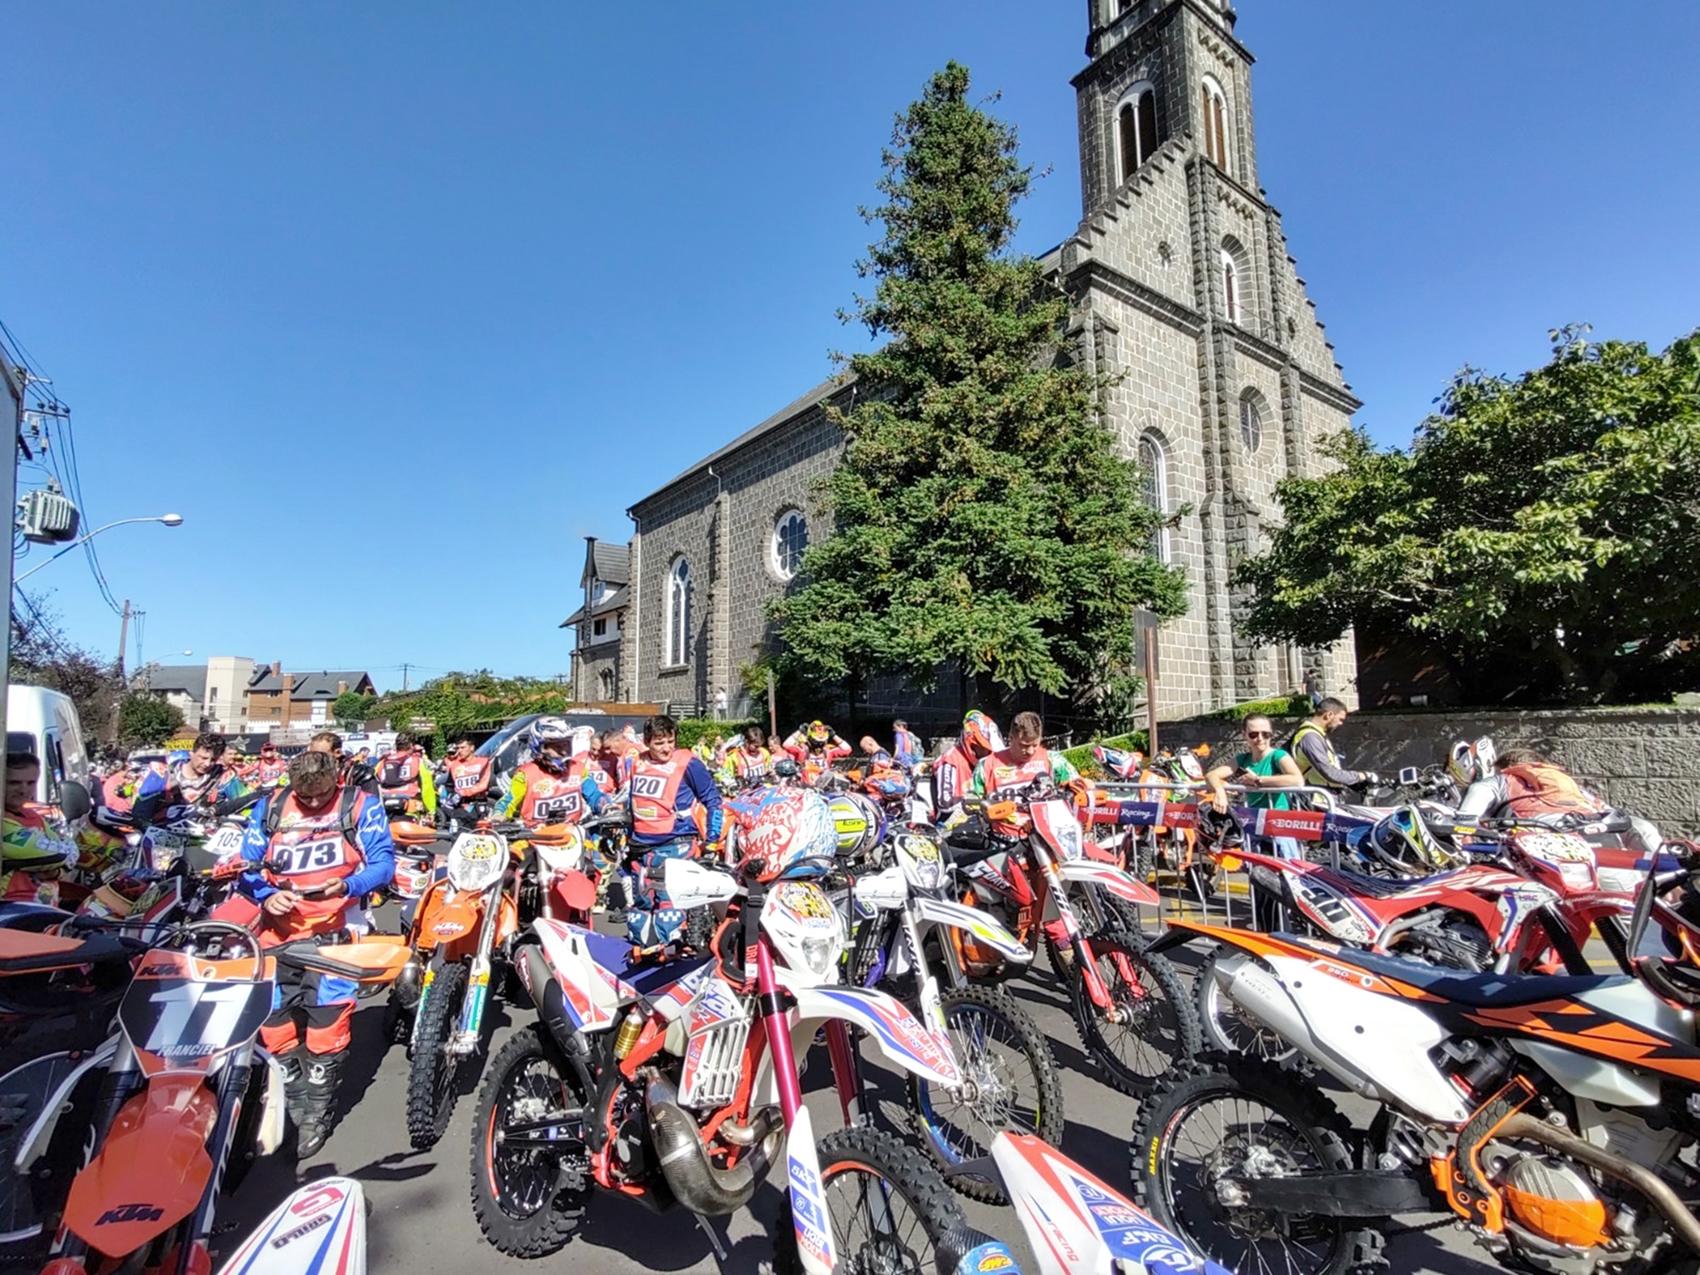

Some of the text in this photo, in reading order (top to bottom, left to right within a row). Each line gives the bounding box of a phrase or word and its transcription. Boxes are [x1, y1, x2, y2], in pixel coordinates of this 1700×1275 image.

[1120, 808, 1156, 819] Racing
[1275, 818, 1321, 831] BORILLI
[216, 831, 242, 848] 105
[94, 1203, 165, 1226] KTM
